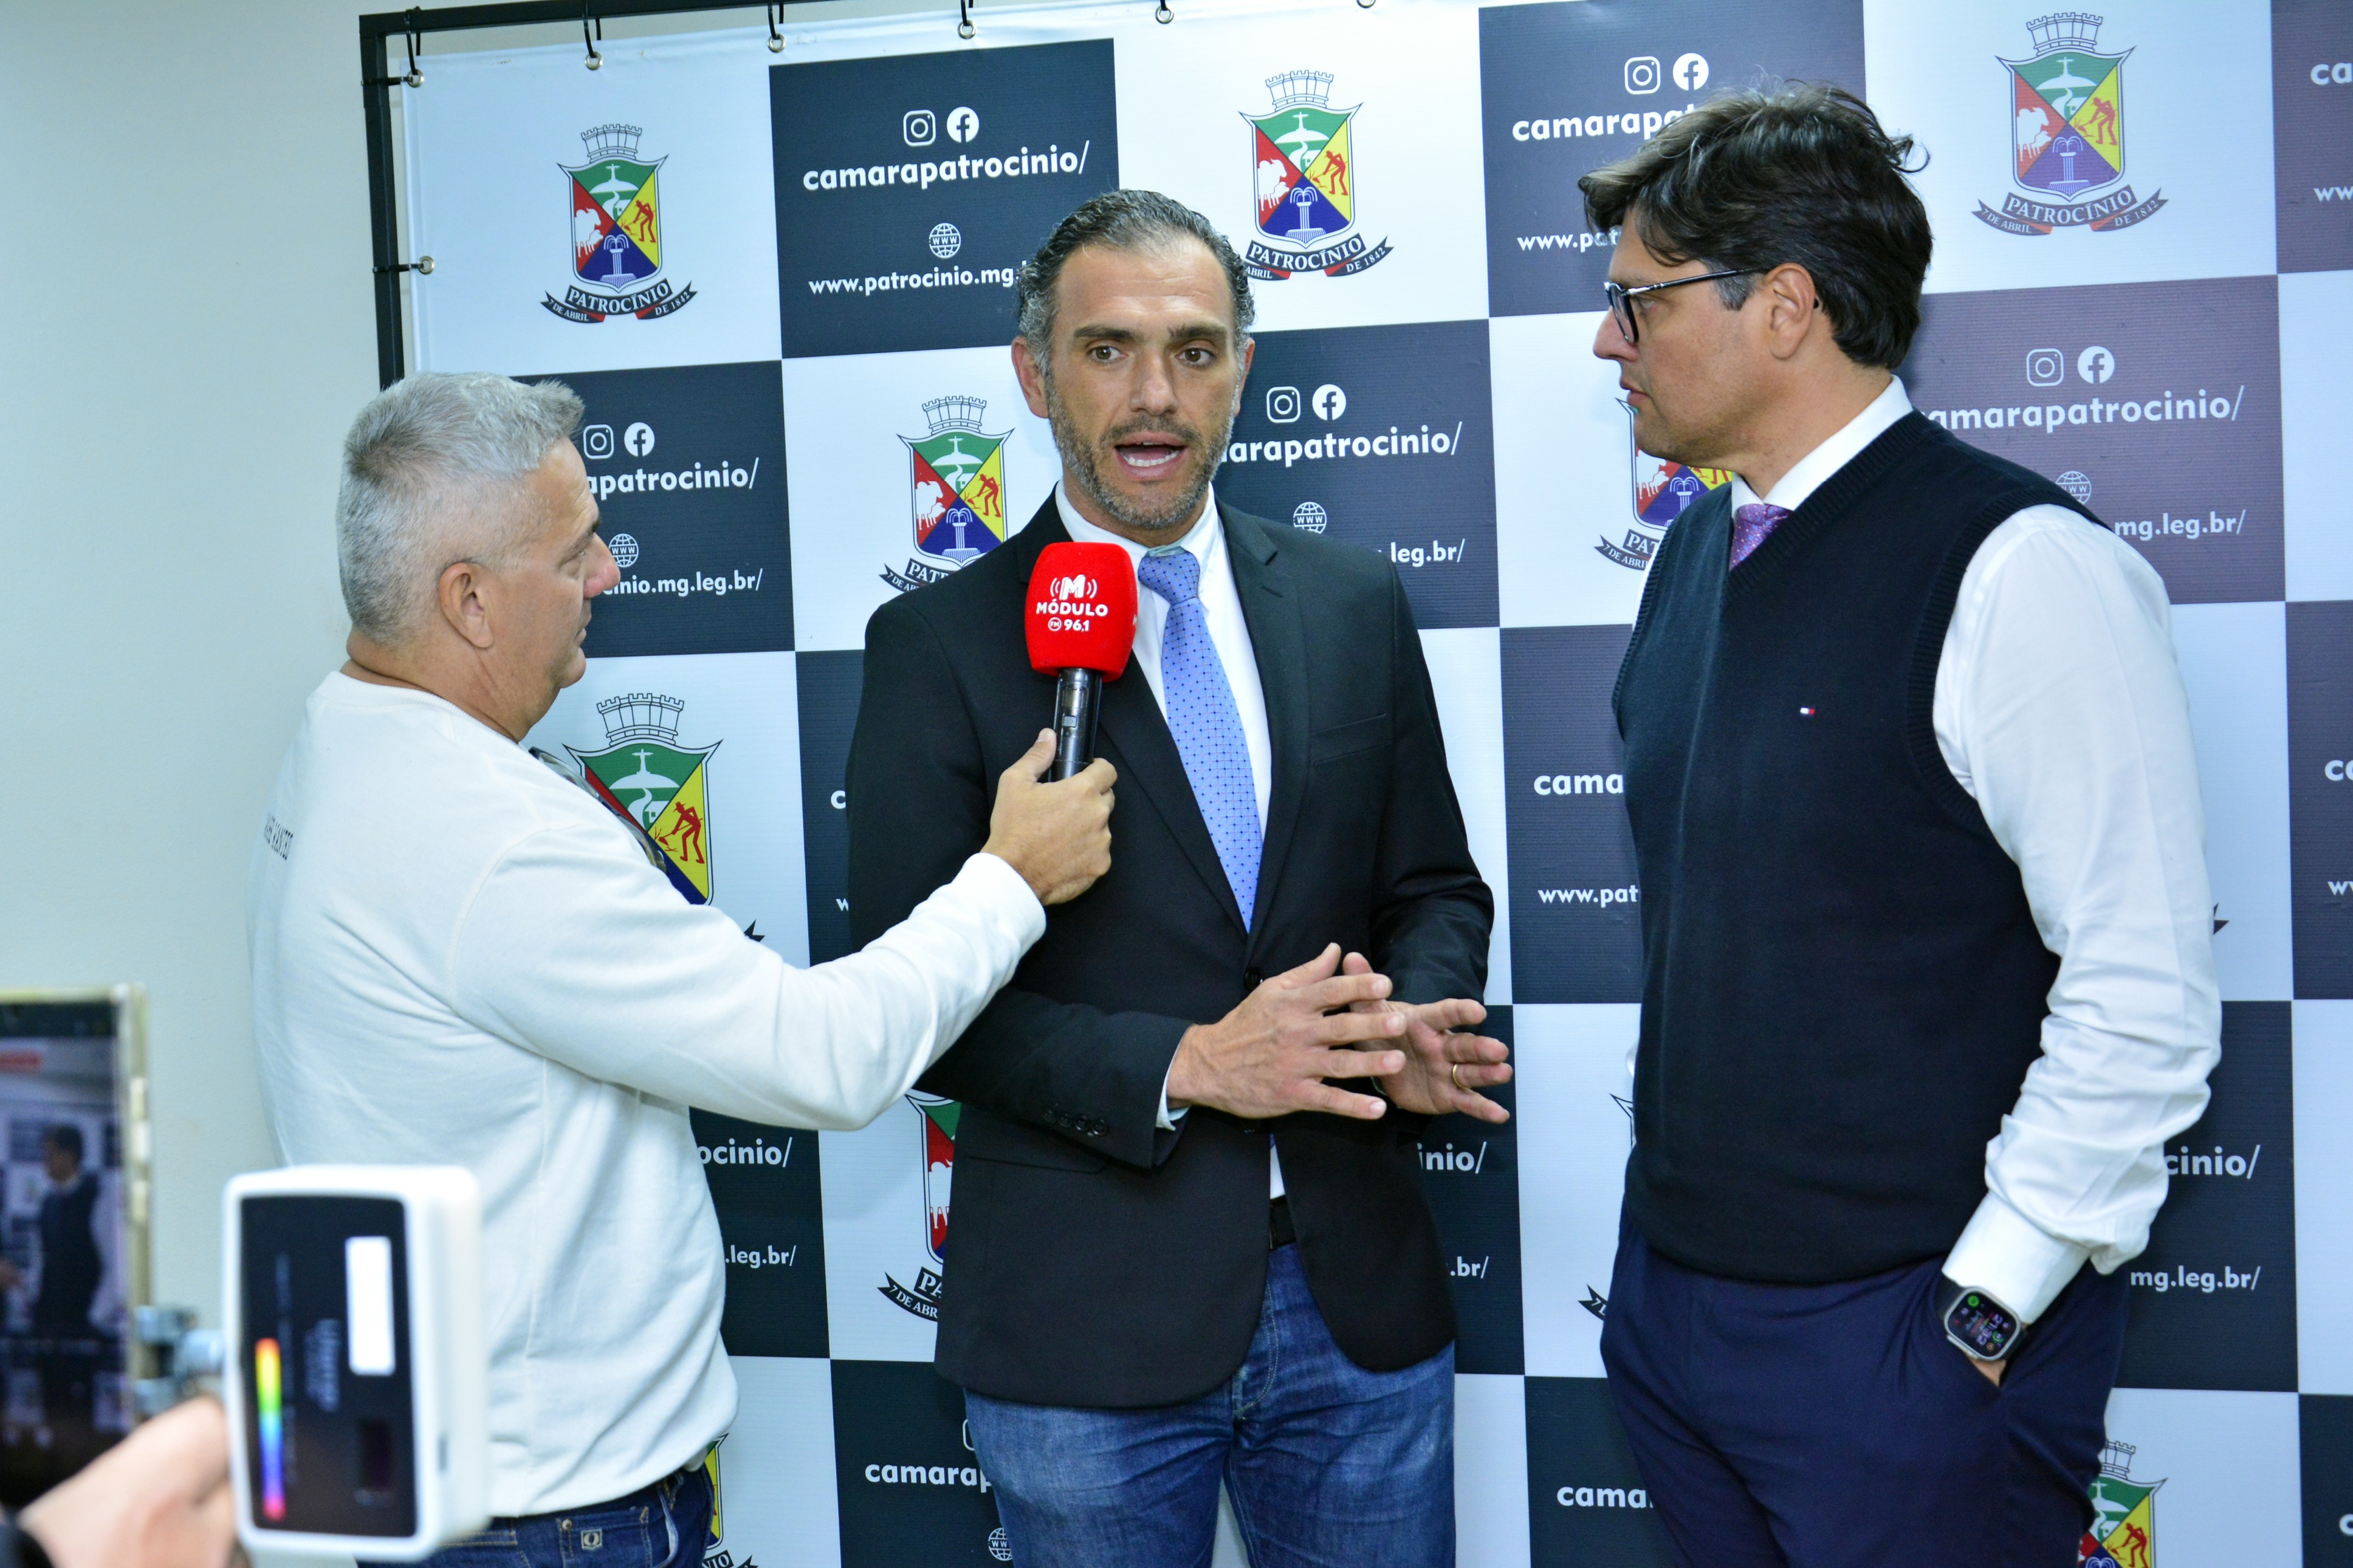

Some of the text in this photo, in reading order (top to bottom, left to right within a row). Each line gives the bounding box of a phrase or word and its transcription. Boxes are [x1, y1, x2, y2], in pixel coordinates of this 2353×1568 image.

[1512, 103, 1695, 141] camarap
[803, 140, 1090, 191] camarapatrocinio/
[2006, 190, 2132, 224] PATROCÍNIO
[2115, 200, 2159, 227] DE 1842
[1987, 213, 1999, 224] DE
[2001, 219, 2032, 233] ABRIL
[1248, 238, 1362, 270] PATROCÍNIO
[1346, 247, 1386, 273] DE 1842
[808, 260, 1026, 296] www.patrocinio.mg.
[1245, 265, 1273, 279] ABRIL
[568, 282, 668, 313] PATROCÍNIO
[655, 292, 690, 315] DE 1842
[552, 303, 565, 314] DE
[564, 309, 589, 321] ABRIL
[1921, 385, 2244, 433] amarapatrocinio/
[1221, 421, 1463, 467] arapatrocinio/
[1608, 548, 1622, 561] DE
[891, 577, 904, 588] DE
[1036, 598, 1108, 617] MÓDULO
[896, 1290, 913, 1307] DE
[1557, 1487, 1654, 1508] cama
